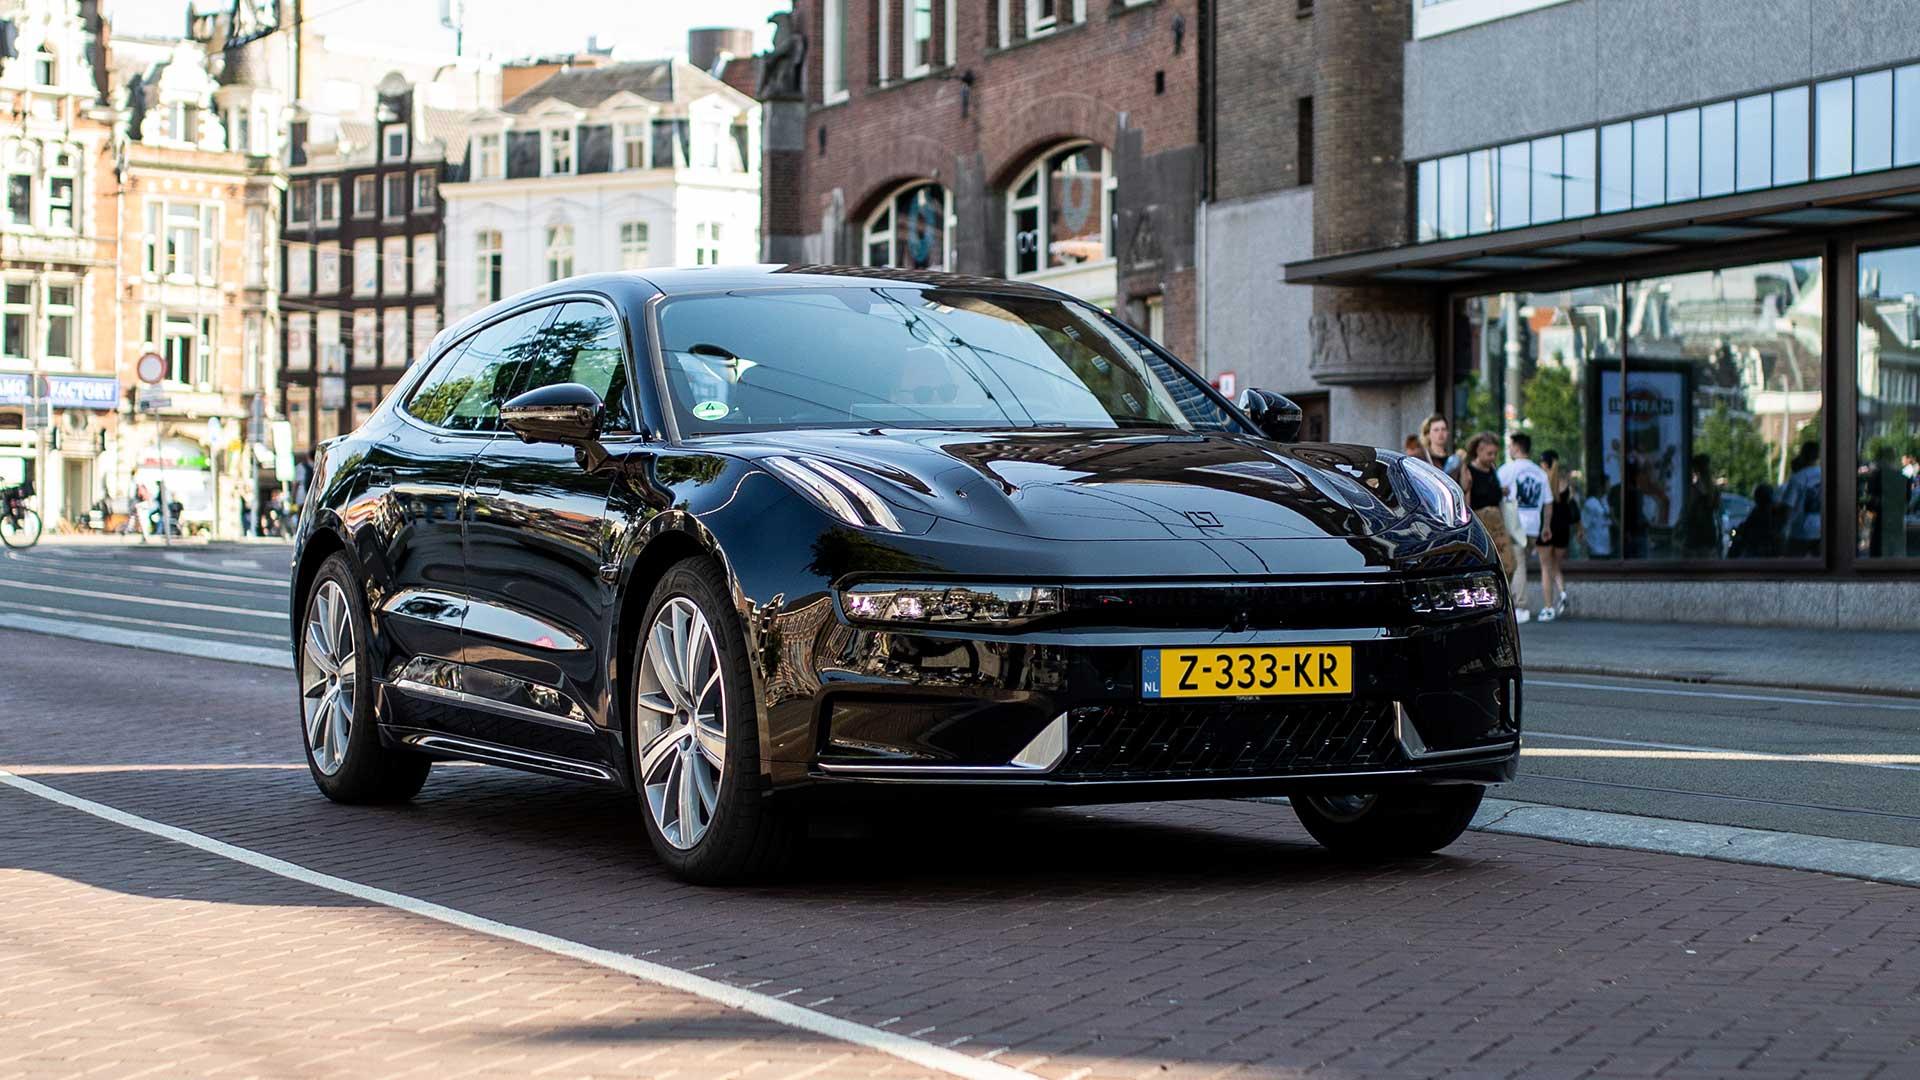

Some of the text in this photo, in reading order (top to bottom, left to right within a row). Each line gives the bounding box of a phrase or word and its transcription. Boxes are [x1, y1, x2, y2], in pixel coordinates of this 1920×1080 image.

[50, 380, 114, 400] FACTORY
[1144, 653, 1339, 692] NL Z-333-KR
